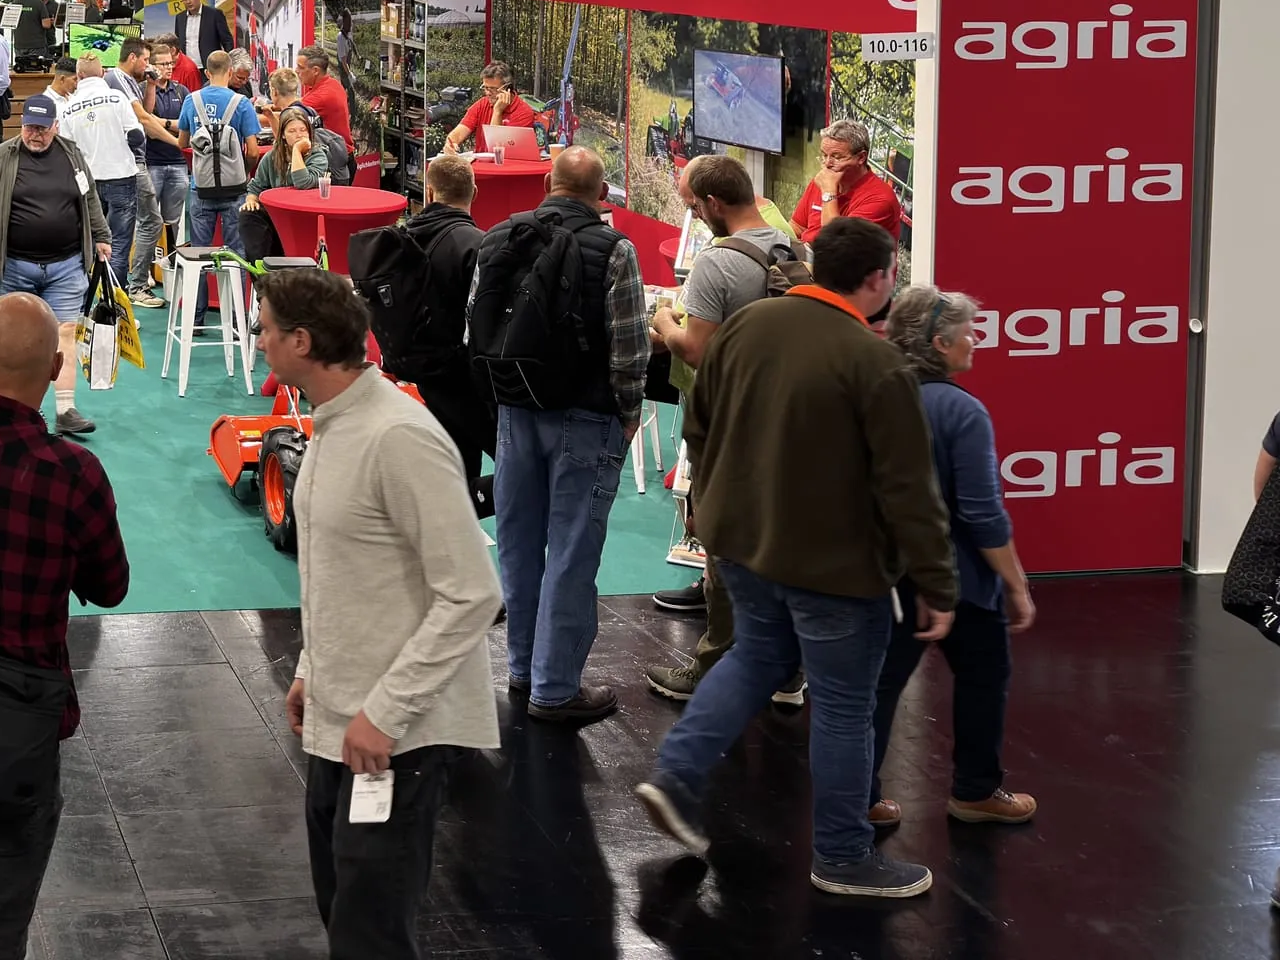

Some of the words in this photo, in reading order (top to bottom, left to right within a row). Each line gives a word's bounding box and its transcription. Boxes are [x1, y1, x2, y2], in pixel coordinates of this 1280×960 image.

[869, 38, 927, 53] 10.0-116
[953, 3, 1187, 69] agria
[63, 95, 120, 119] NORDIC
[950, 147, 1183, 214] agria
[1000, 431, 1176, 499] gria
